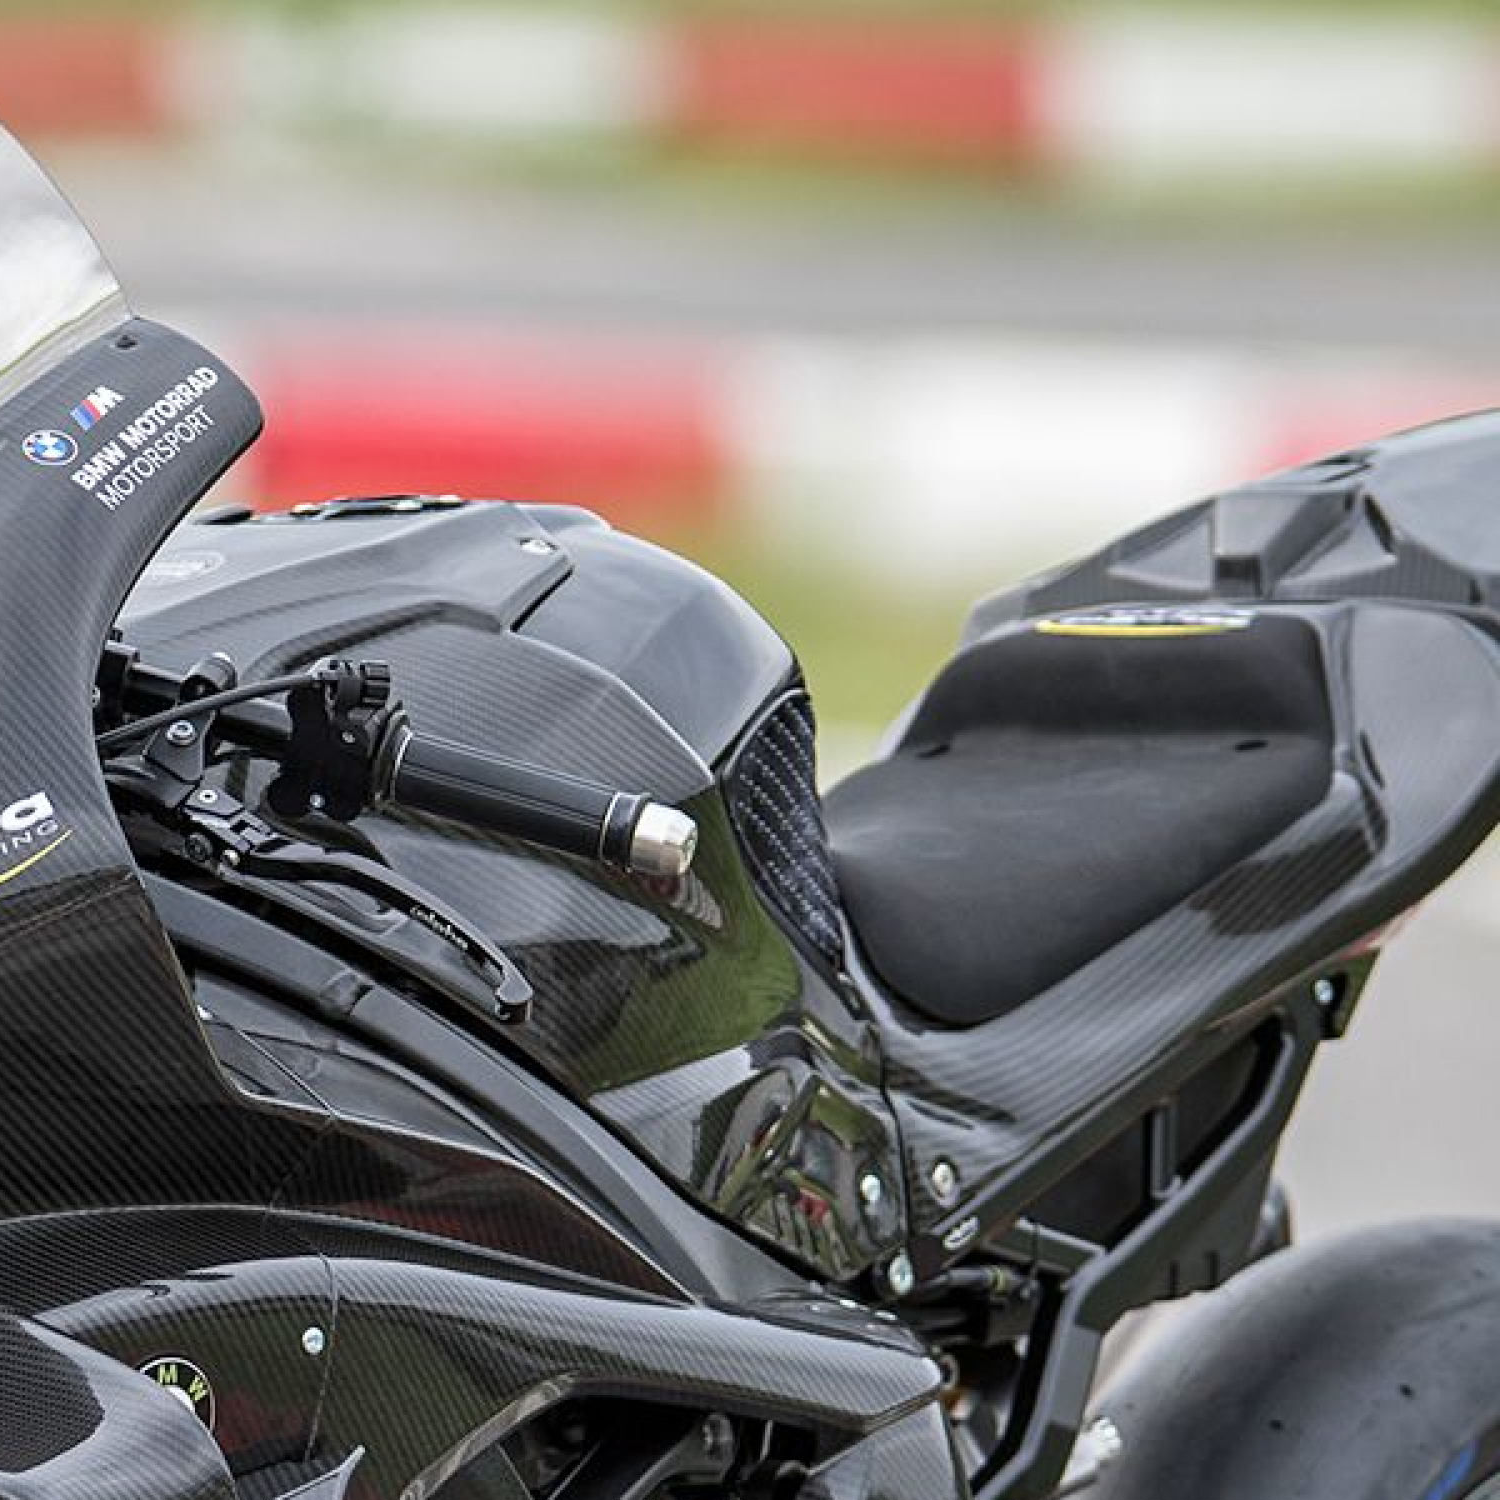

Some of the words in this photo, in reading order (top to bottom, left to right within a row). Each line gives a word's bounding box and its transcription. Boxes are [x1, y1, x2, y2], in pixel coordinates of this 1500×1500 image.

[71, 441, 127, 491] BMW
[117, 366, 219, 450] MOTORRAD
[97, 404, 215, 511] MOTORSPORT
[157, 1364, 209, 1401] MW
